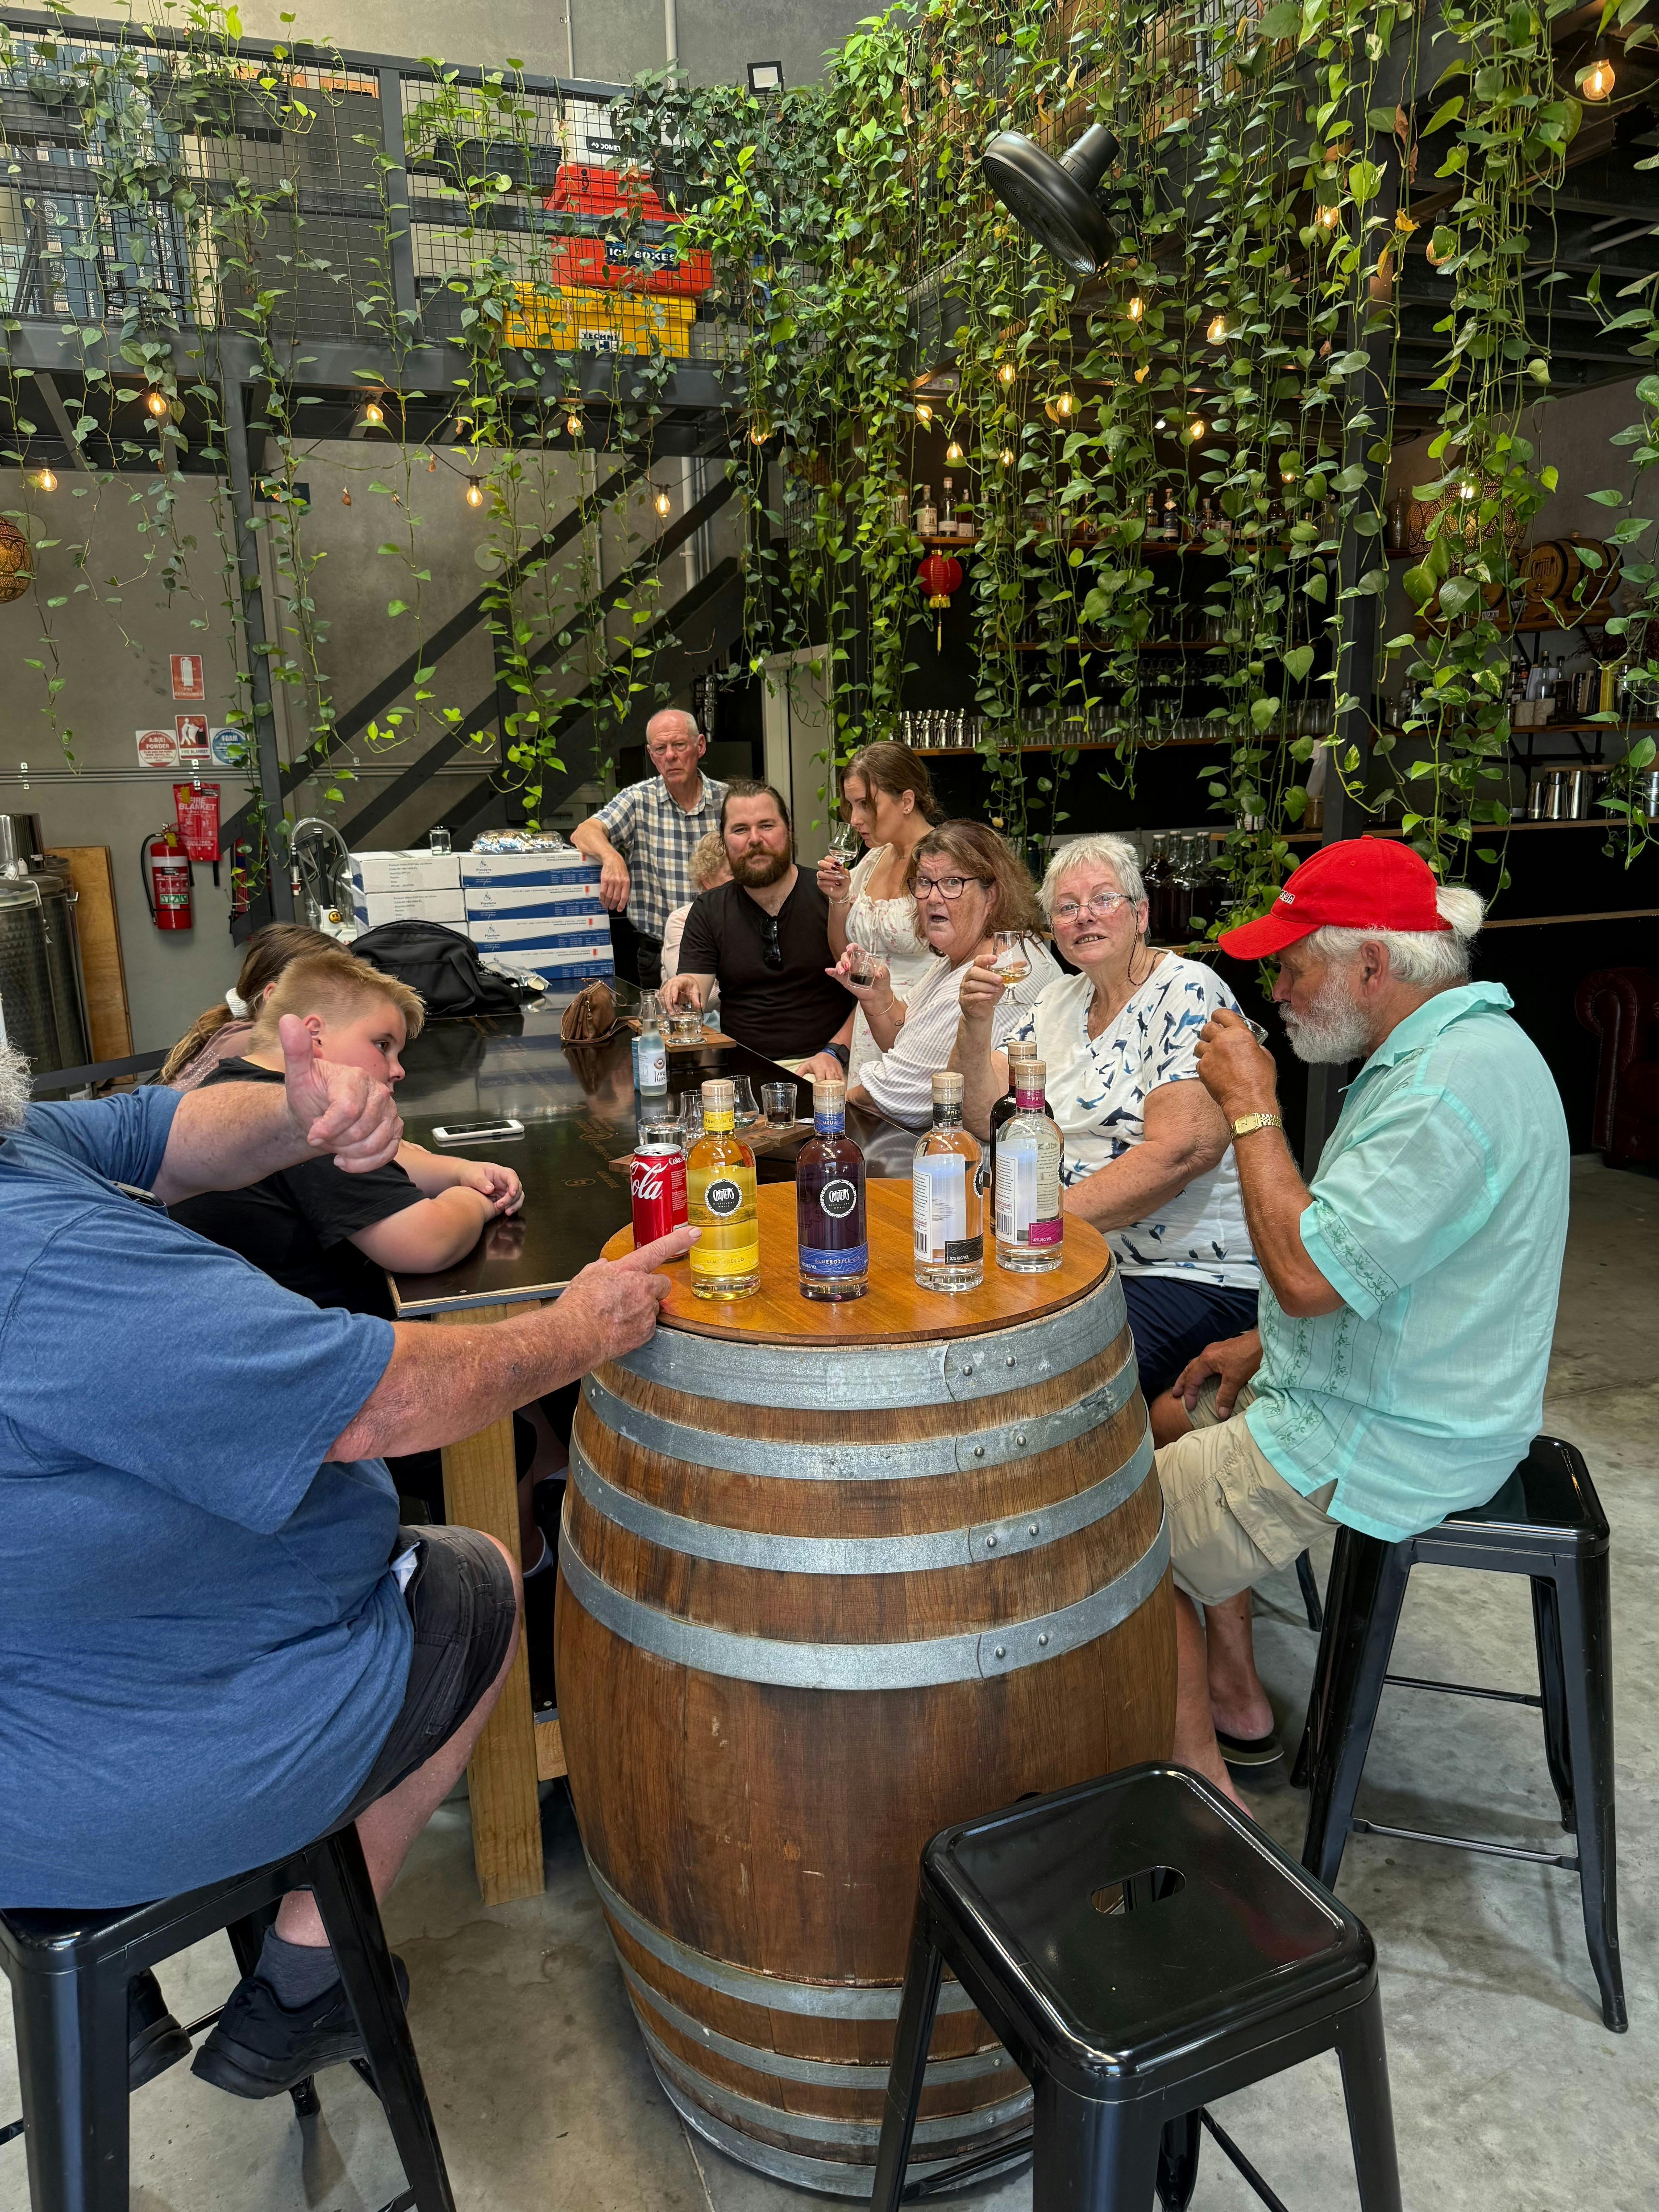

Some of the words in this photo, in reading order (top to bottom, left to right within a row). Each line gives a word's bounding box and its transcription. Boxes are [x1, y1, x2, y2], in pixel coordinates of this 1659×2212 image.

[600, 143, 621, 151] DOMET
[1531, 556, 1558, 580] CRITTERS
[713, 1188, 734, 1201] CRITTERS
[829, 1188, 850, 1203] CRITTERS
